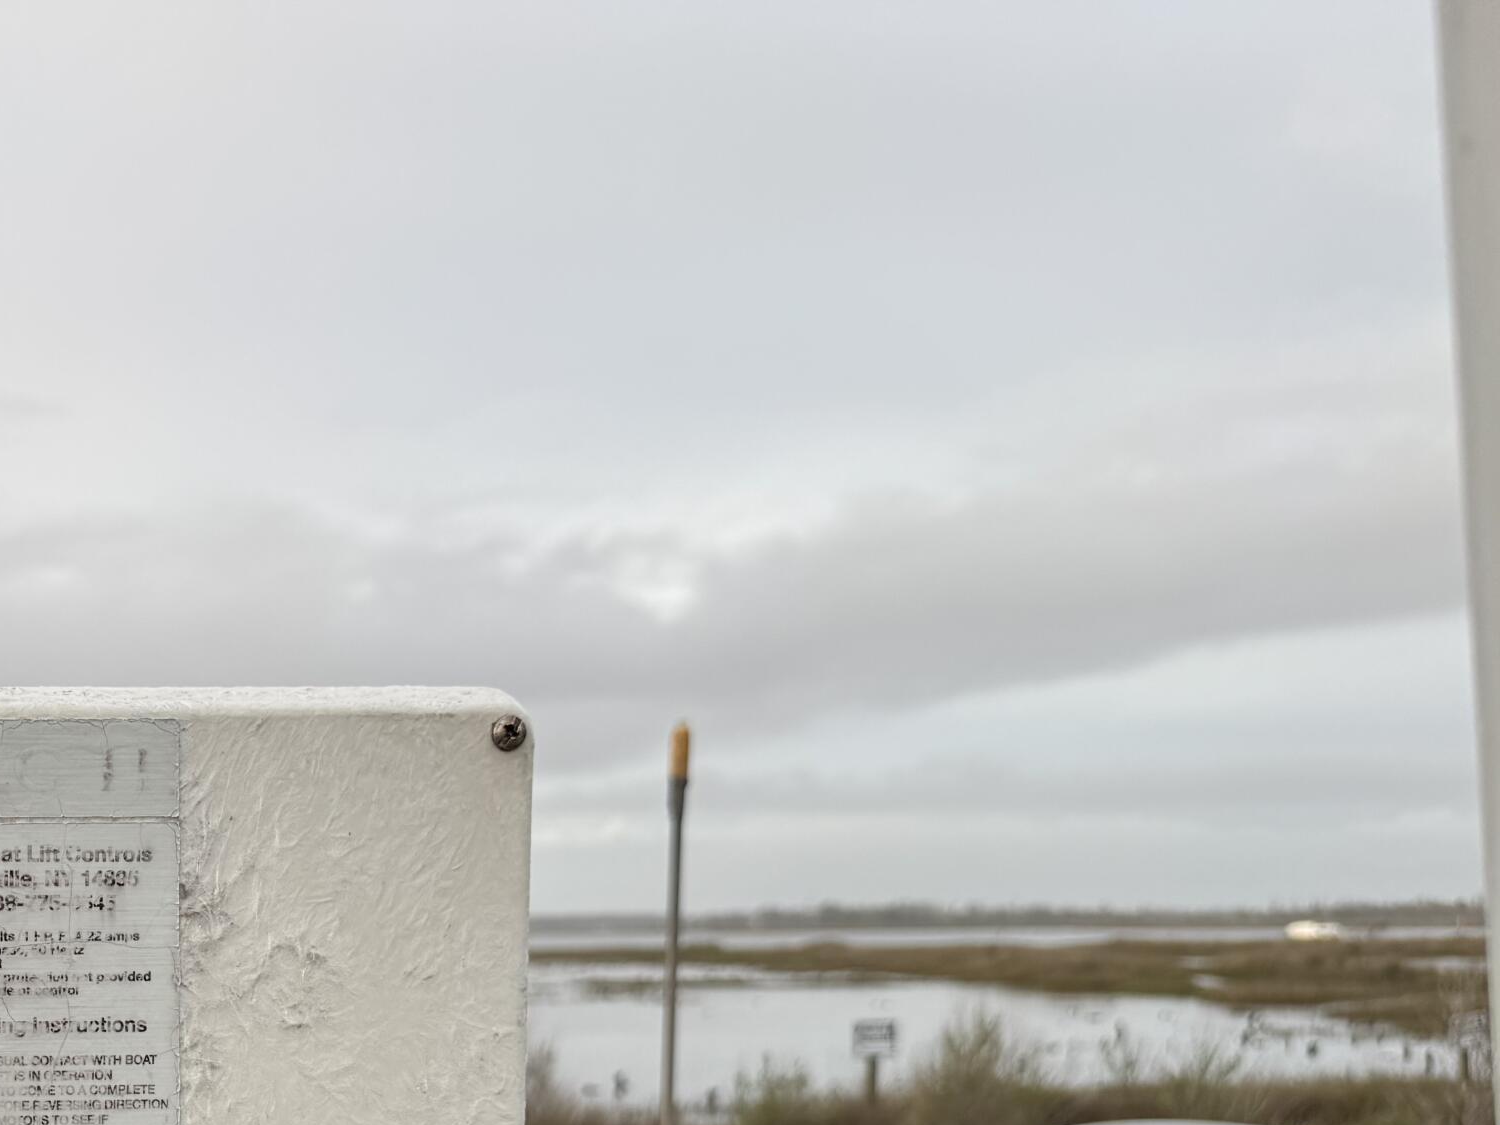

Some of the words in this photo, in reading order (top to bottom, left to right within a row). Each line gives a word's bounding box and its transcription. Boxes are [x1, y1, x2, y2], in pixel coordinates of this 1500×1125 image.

[27, 845, 60, 862] Lift
[65, 845, 153, 862] Controls
[96, 971, 151, 985] povided
[91, 1054, 122, 1065] WITH
[126, 1054, 157, 1065] BOAT
[14, 1071, 26, 1081] IS
[29, 1070, 41, 1081] IN
[58, 1085, 75, 1095] TO
[77, 1085, 87, 1095] A
[89, 1084, 156, 1095] COMPLETE
[105, 1098, 169, 1110] DIRECTION
[52, 1114, 69, 1125] TO
[71, 1114, 95, 1125] SEE
[98, 1114, 109, 1125] IF
